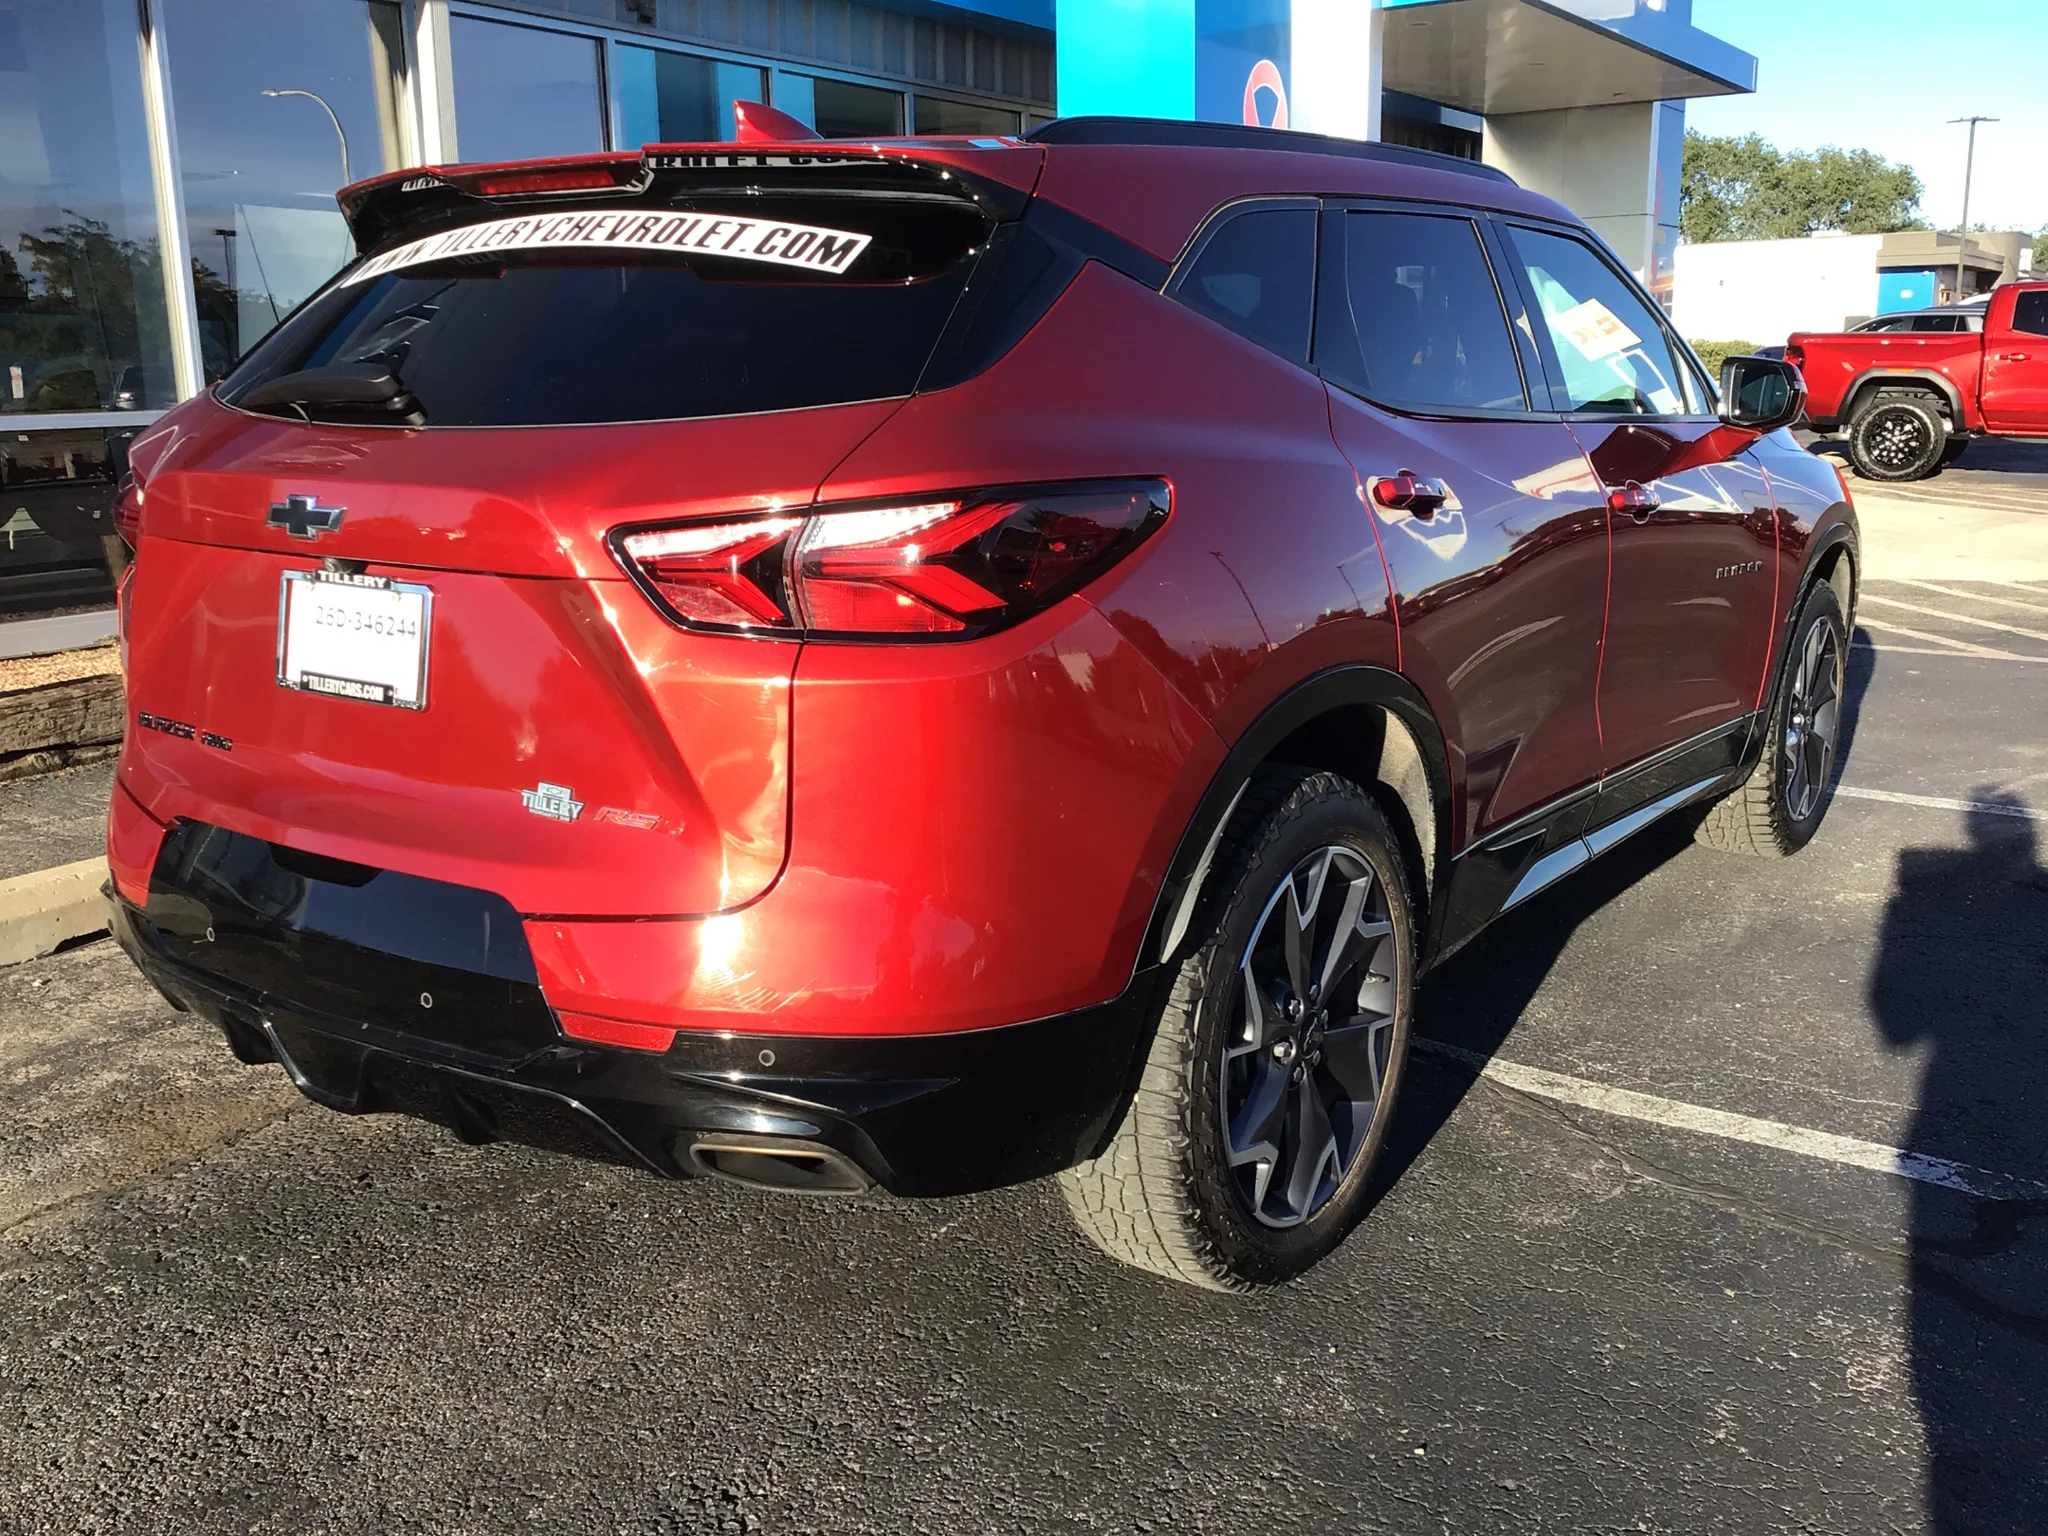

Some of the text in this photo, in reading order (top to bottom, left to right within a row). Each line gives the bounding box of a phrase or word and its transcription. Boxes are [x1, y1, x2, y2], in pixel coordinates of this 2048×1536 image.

[318, 571, 387, 588] TILLERY
[308, 675, 384, 701] TILLERYCARS.COM
[521, 791, 585, 819] TILLERY
[594, 807, 660, 830] RS
